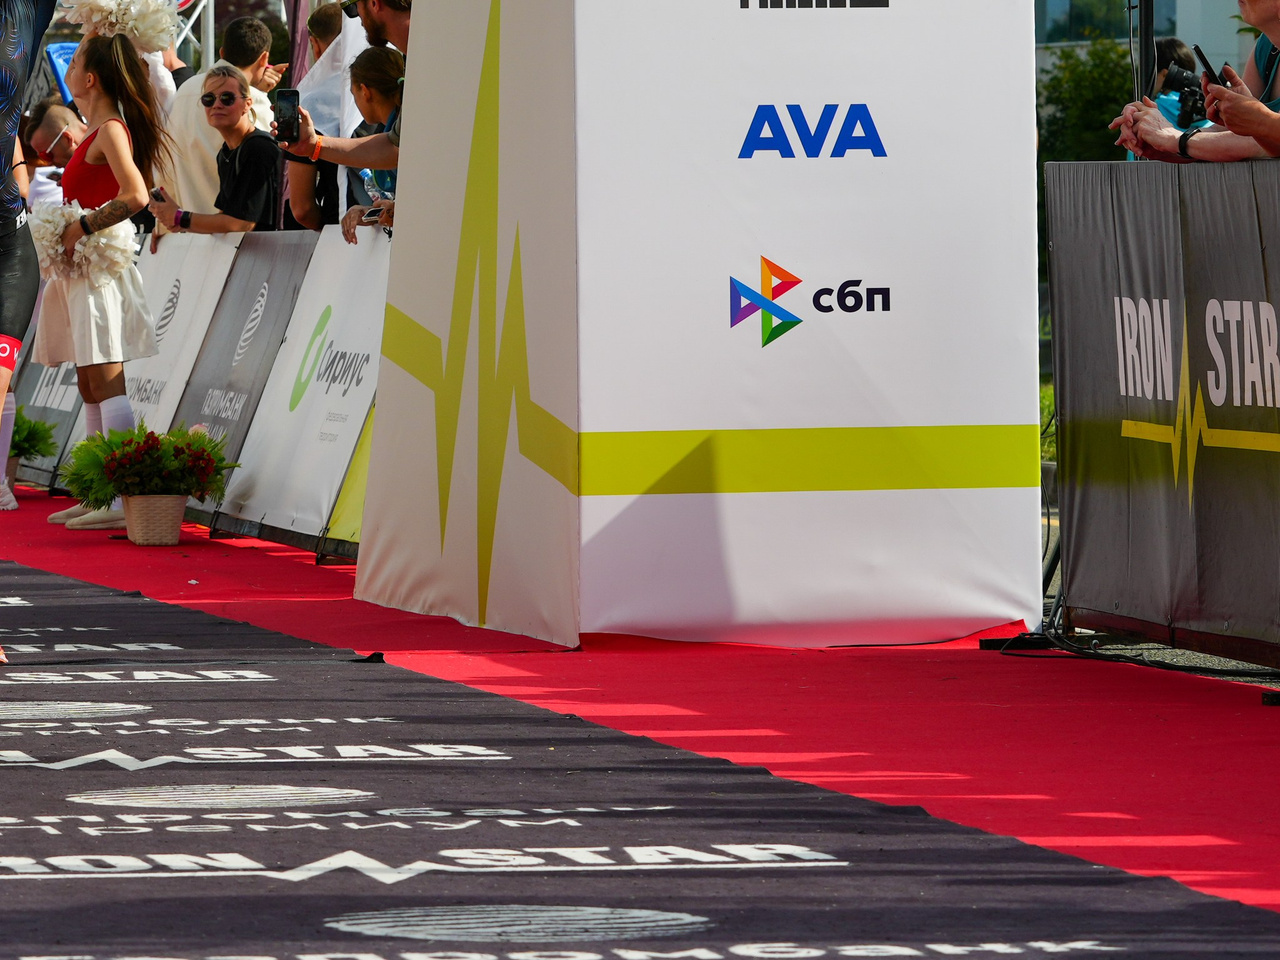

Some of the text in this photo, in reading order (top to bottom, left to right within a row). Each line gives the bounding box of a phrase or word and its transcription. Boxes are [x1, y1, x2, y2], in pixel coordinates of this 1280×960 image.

[738, 103, 888, 159] AVA
[812, 279, 891, 313] сбп
[316, 339, 370, 397] Сириус
[1114, 296, 1280, 408] IRON STAR
[5, 670, 274, 682] STAR
[184, 744, 505, 760] STAR
[436, 844, 837, 866] STAR
